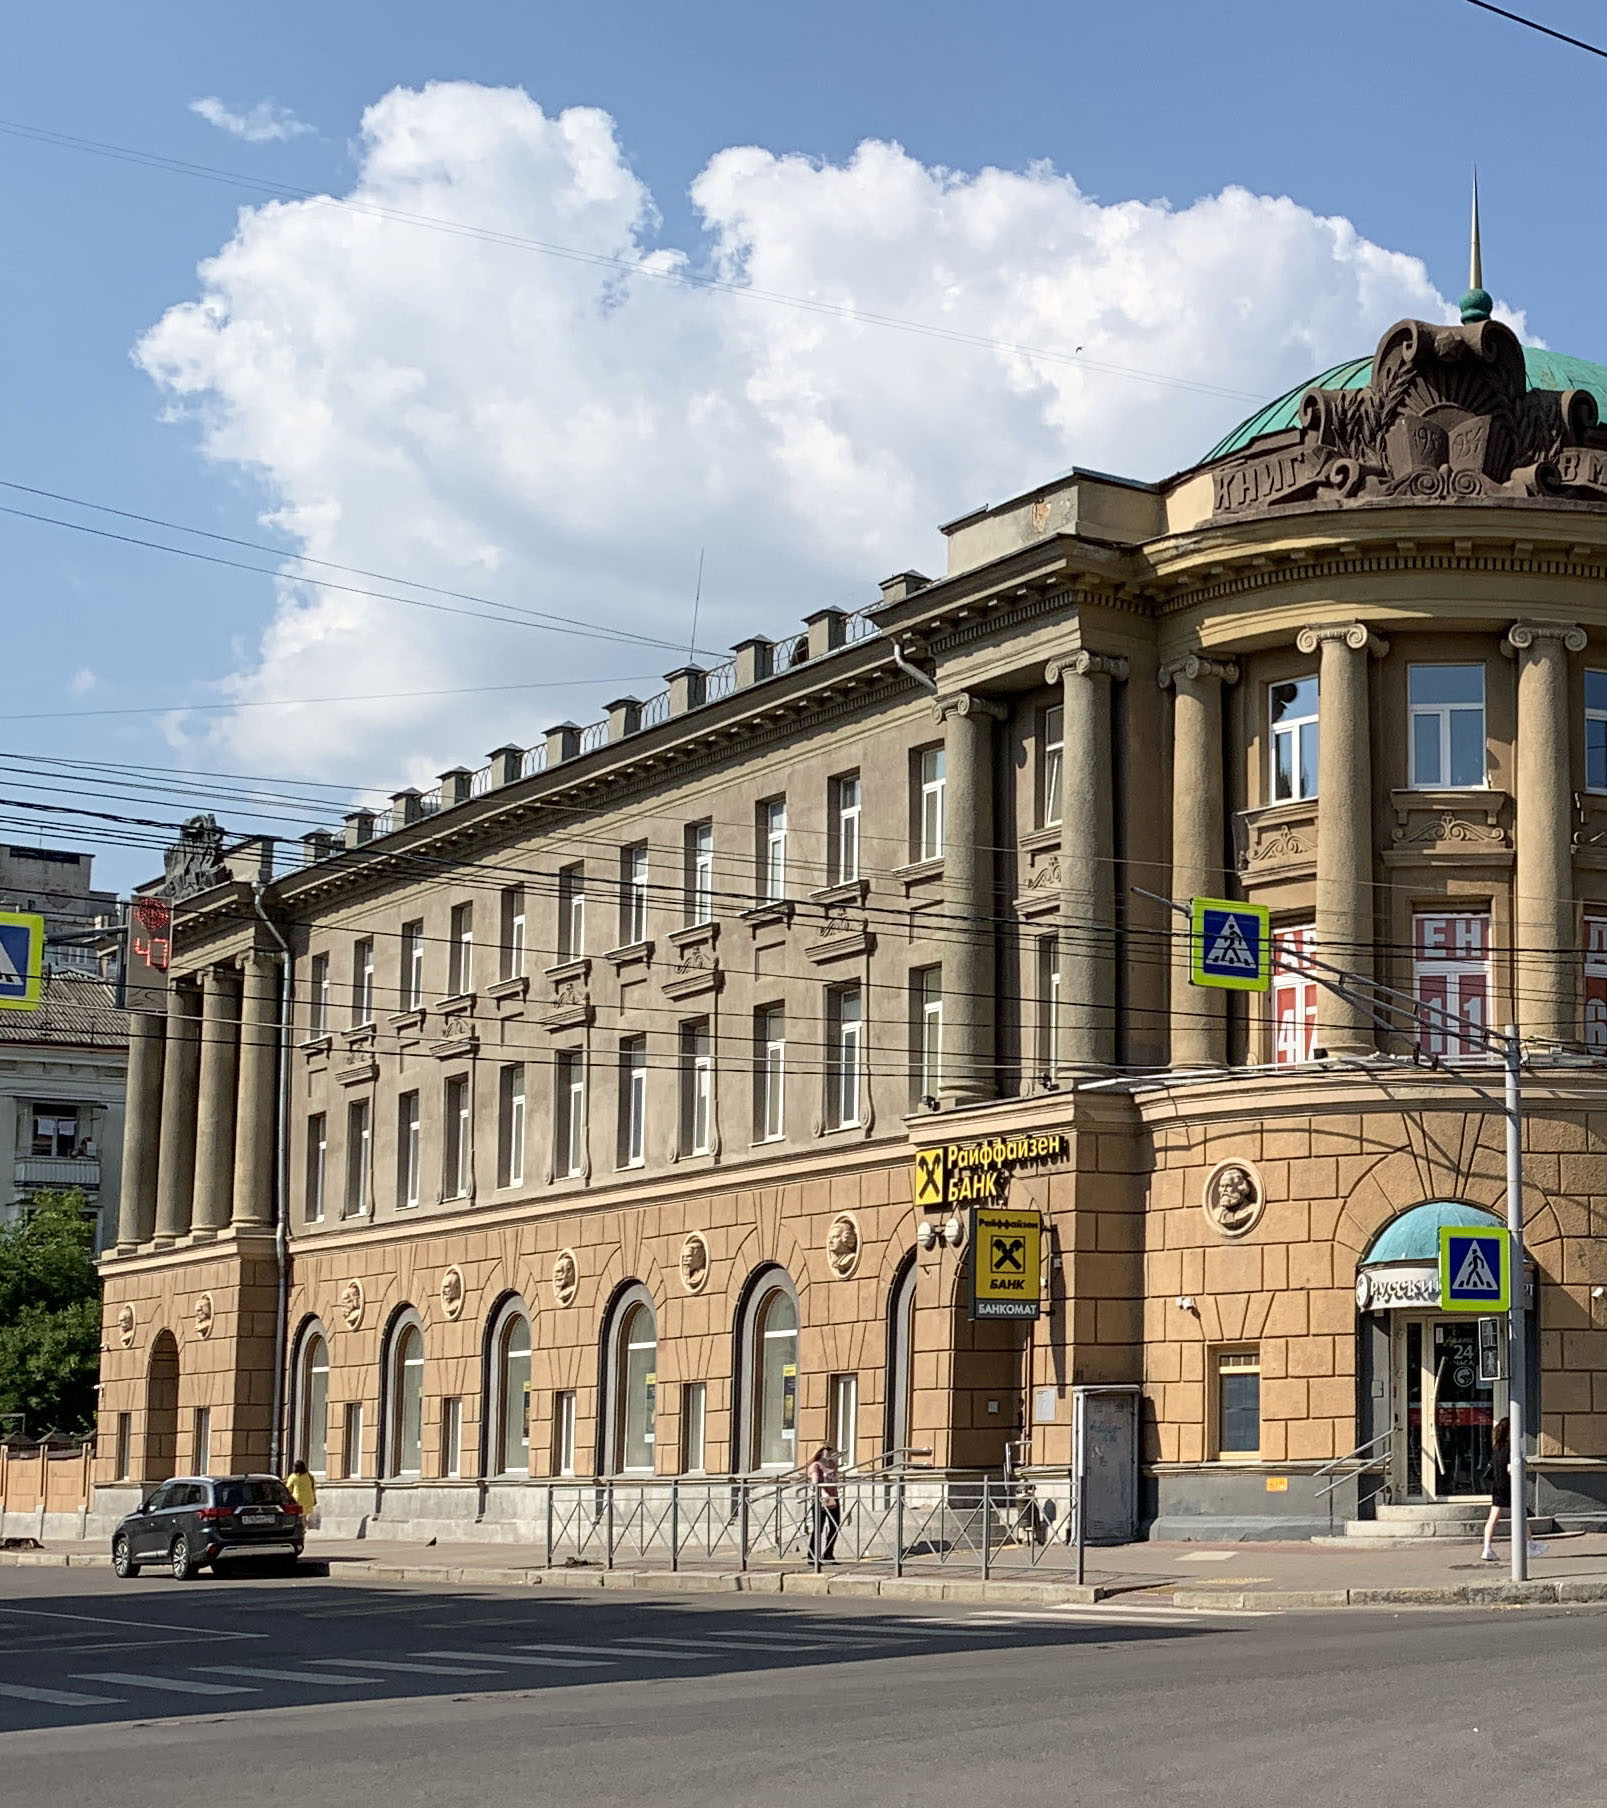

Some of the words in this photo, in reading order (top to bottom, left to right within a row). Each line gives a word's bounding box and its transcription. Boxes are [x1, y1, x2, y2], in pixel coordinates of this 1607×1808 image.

[1216, 449, 1330, 511] КНИГУ
[1558, 452, 1580, 482] В
[947, 1134, 1061, 1170] Райффайзен
[948, 1172, 998, 1202] БАНК
[989, 1279, 1026, 1291] БАНК
[978, 1303, 1037, 1316] БАНКОМАТ
[1453, 1344, 1475, 1360] 24
